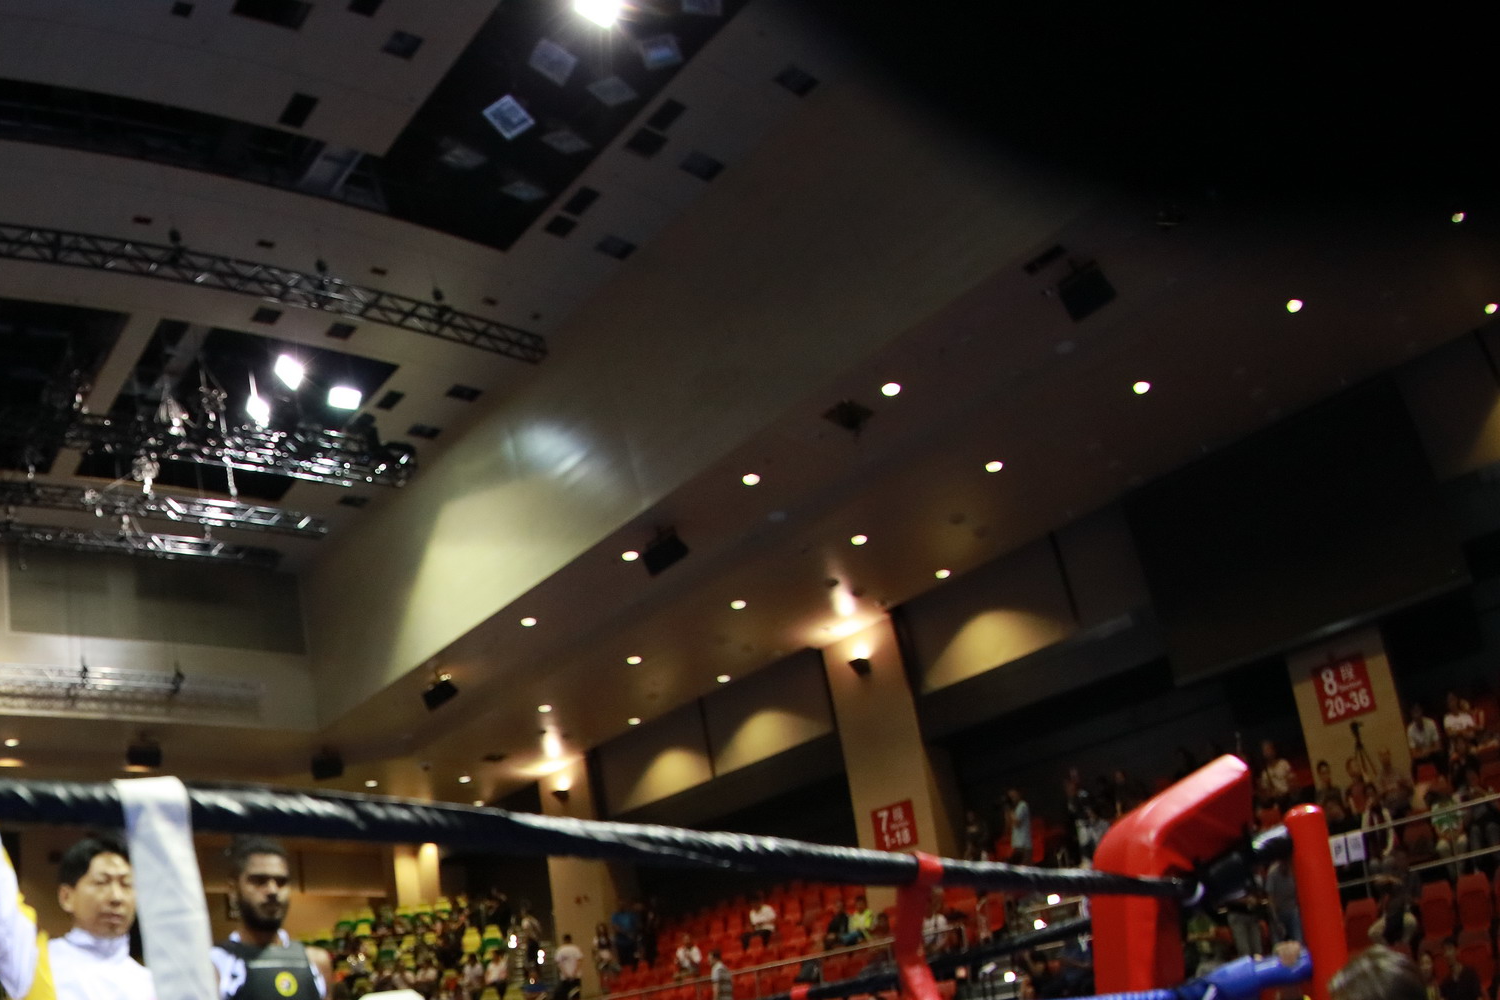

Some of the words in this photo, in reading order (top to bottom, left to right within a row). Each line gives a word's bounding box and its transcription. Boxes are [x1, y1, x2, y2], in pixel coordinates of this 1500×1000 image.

[1321, 669, 1337, 696] 8
[1325, 688, 1370, 719] 20-36
[877, 810, 889, 833] 7
